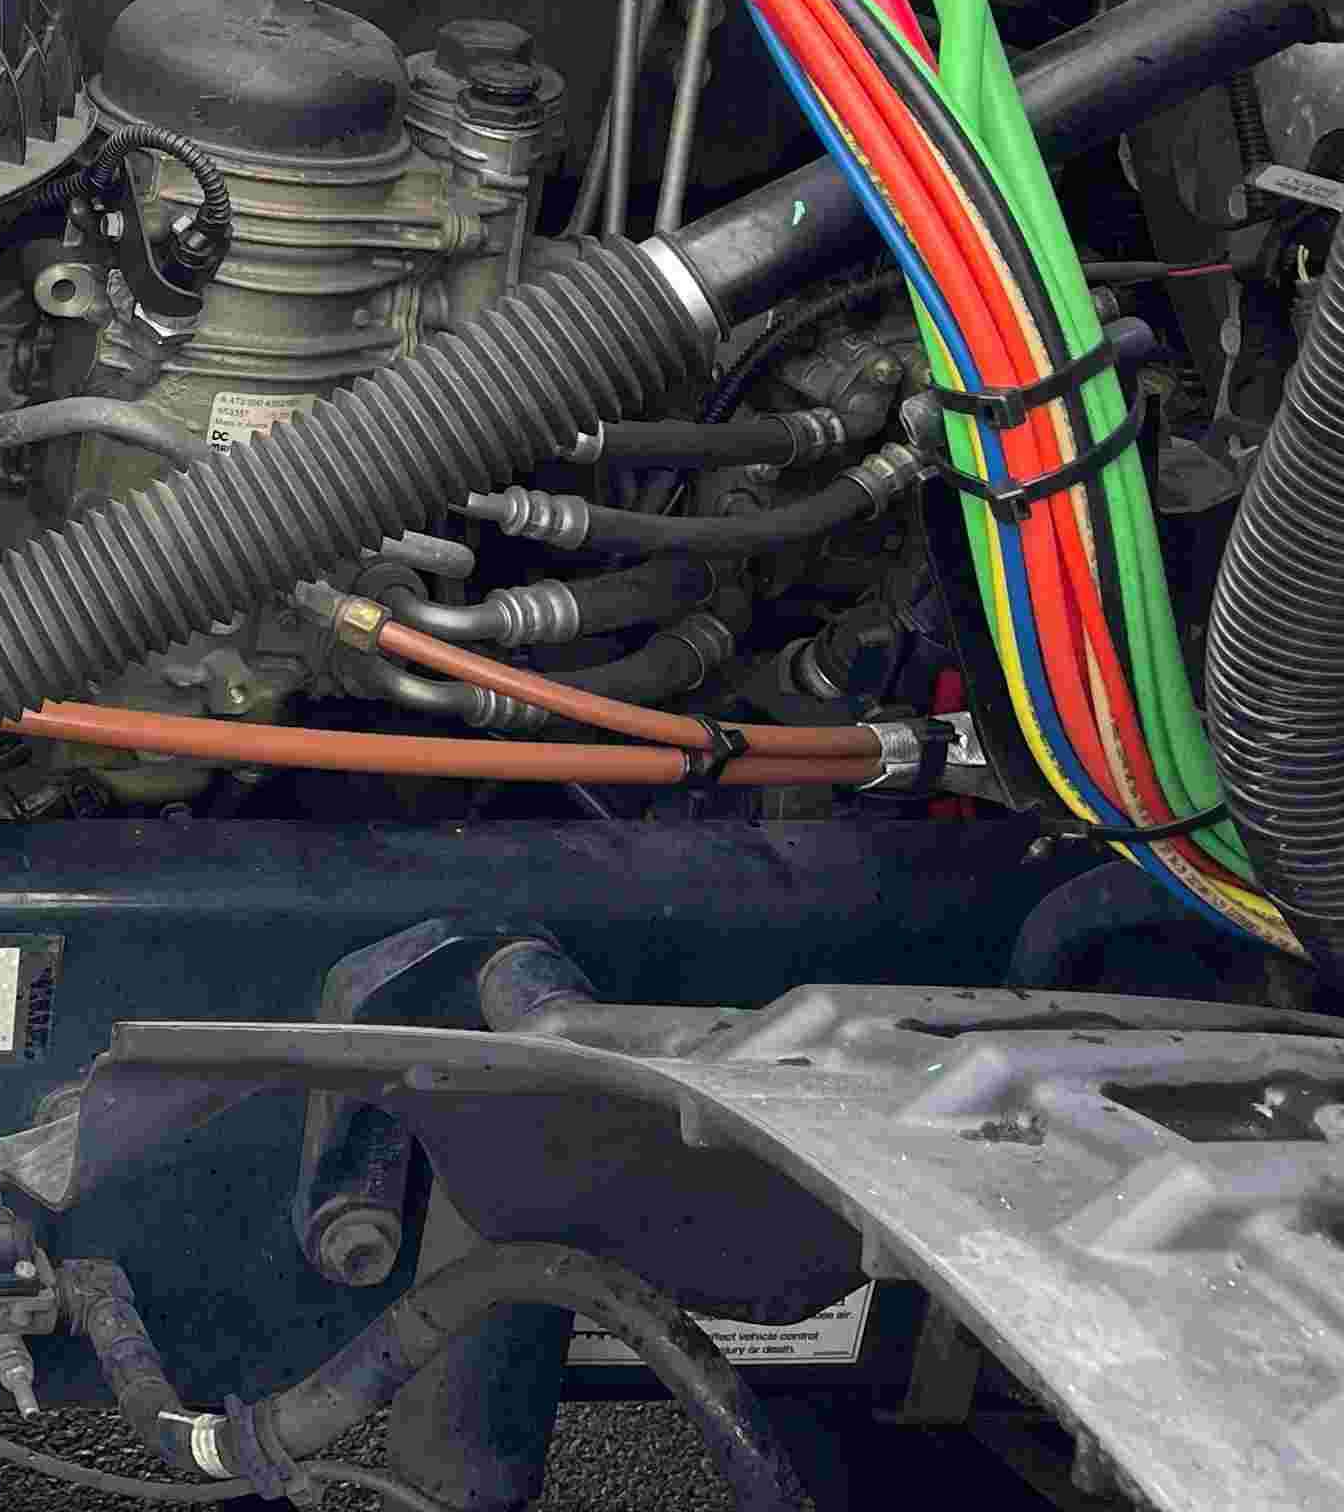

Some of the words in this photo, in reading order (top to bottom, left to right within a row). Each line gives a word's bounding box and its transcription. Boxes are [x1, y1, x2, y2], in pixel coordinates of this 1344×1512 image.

[213, 429, 230, 441] DC
[736, 1330, 777, 1341] vehicle
[780, 1331, 819, 1342] control
